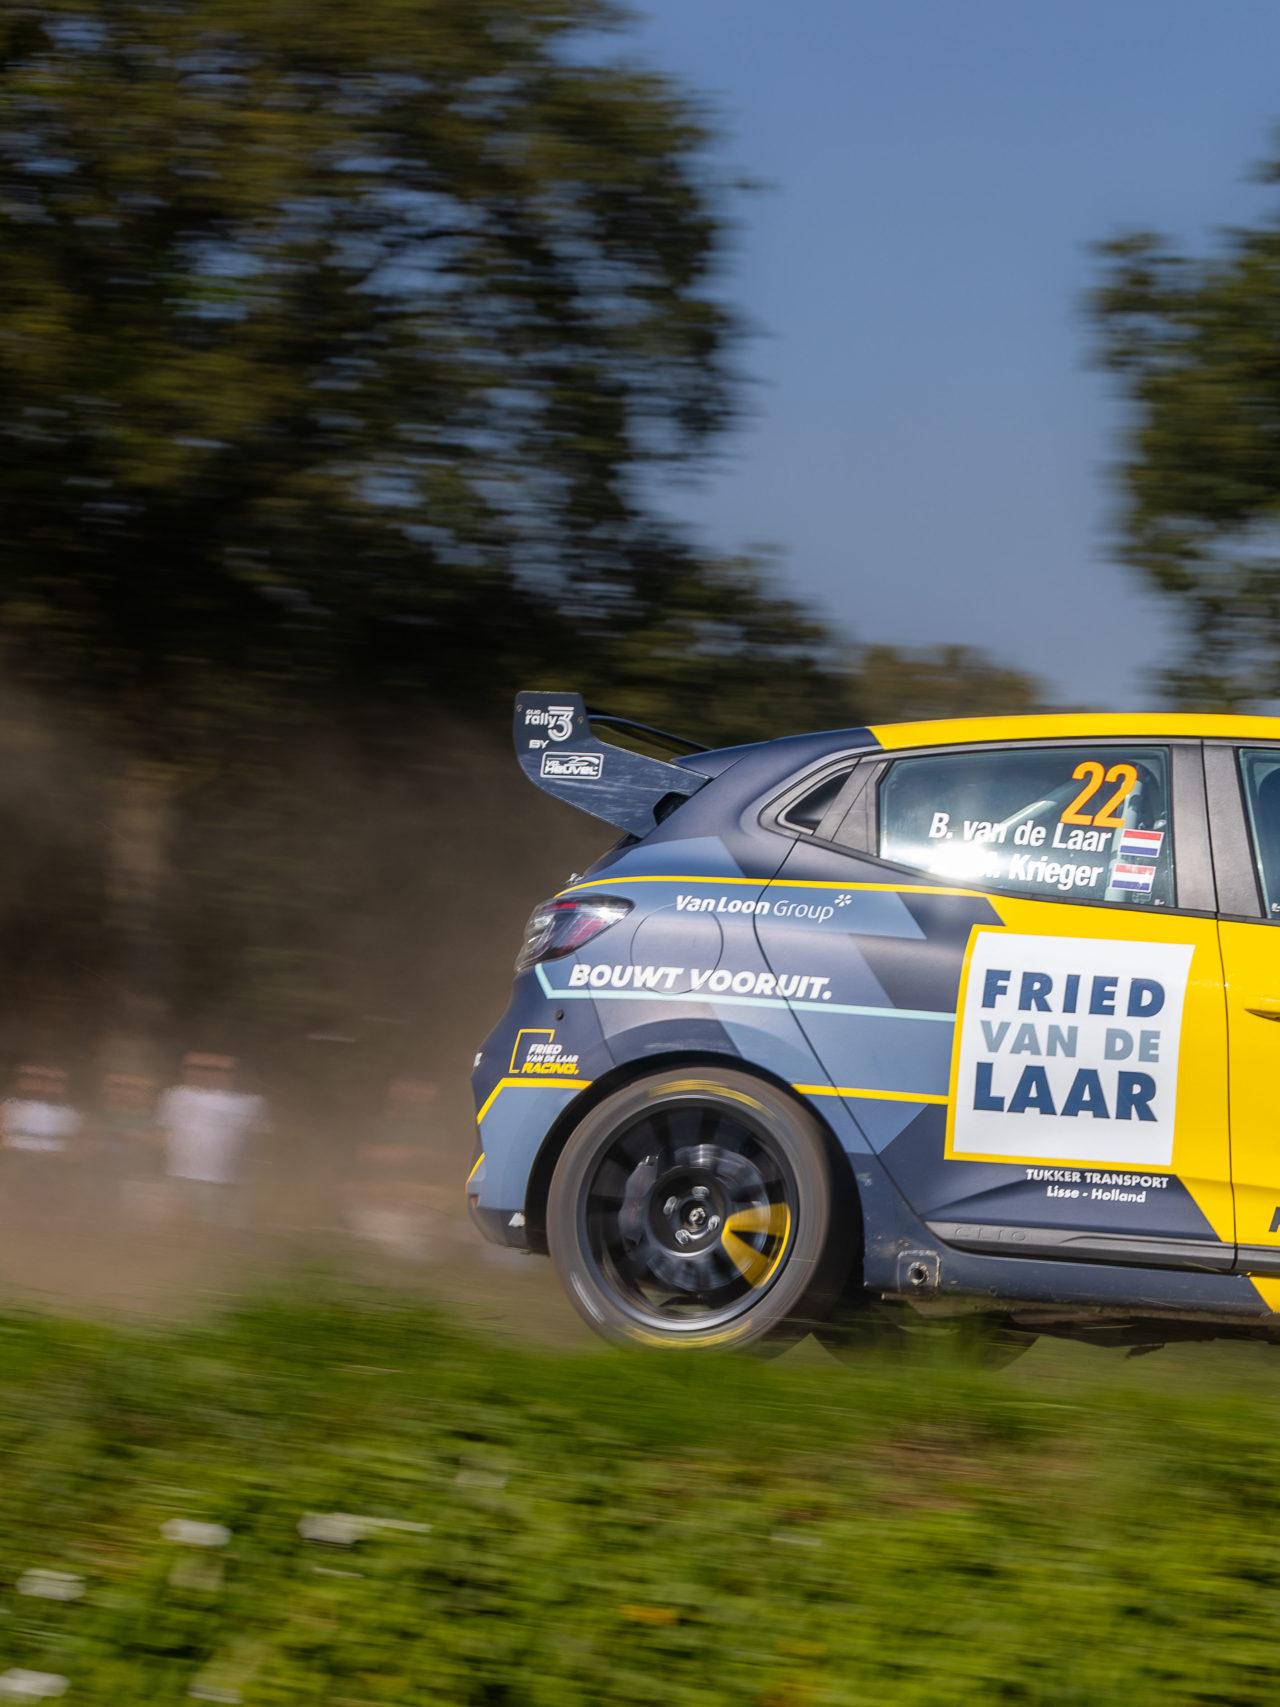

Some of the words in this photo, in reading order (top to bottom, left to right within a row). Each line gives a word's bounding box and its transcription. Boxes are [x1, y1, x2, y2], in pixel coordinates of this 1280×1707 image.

[525, 712, 557, 728] rally
[548, 706, 574, 741] 3
[529, 740, 549, 749] BY
[1060, 761, 1138, 829] 22
[928, 812, 953, 839] B.
[963, 820, 1005, 844] van
[1014, 820, 1046, 847] de
[1052, 823, 1112, 852] Laar
[1008, 853, 1103, 891] Krieger
[676, 895, 714, 912] Van
[716, 896, 770, 915] Loon
[773, 900, 834, 923] Group
[568, 964, 684, 989] BOUWT
[690, 968, 832, 1000] VOORUIT.
[981, 969, 1166, 1018] FRIED
[526, 1054, 541, 1062] VAN
[556, 1055, 579, 1063] LAAR
[528, 1043, 562, 1055] FRIED
[980, 1020, 1078, 1058] VAN
[1103, 1028, 1161, 1063] DE
[972, 1061, 1159, 1122] LAAR
[1025, 1168, 1082, 1183] TUKKER
[1084, 1172, 1169, 1189] TRANSPORT
[1046, 1185, 1080, 1199] Lisse
[1091, 1189, 1147, 1203] Holland
